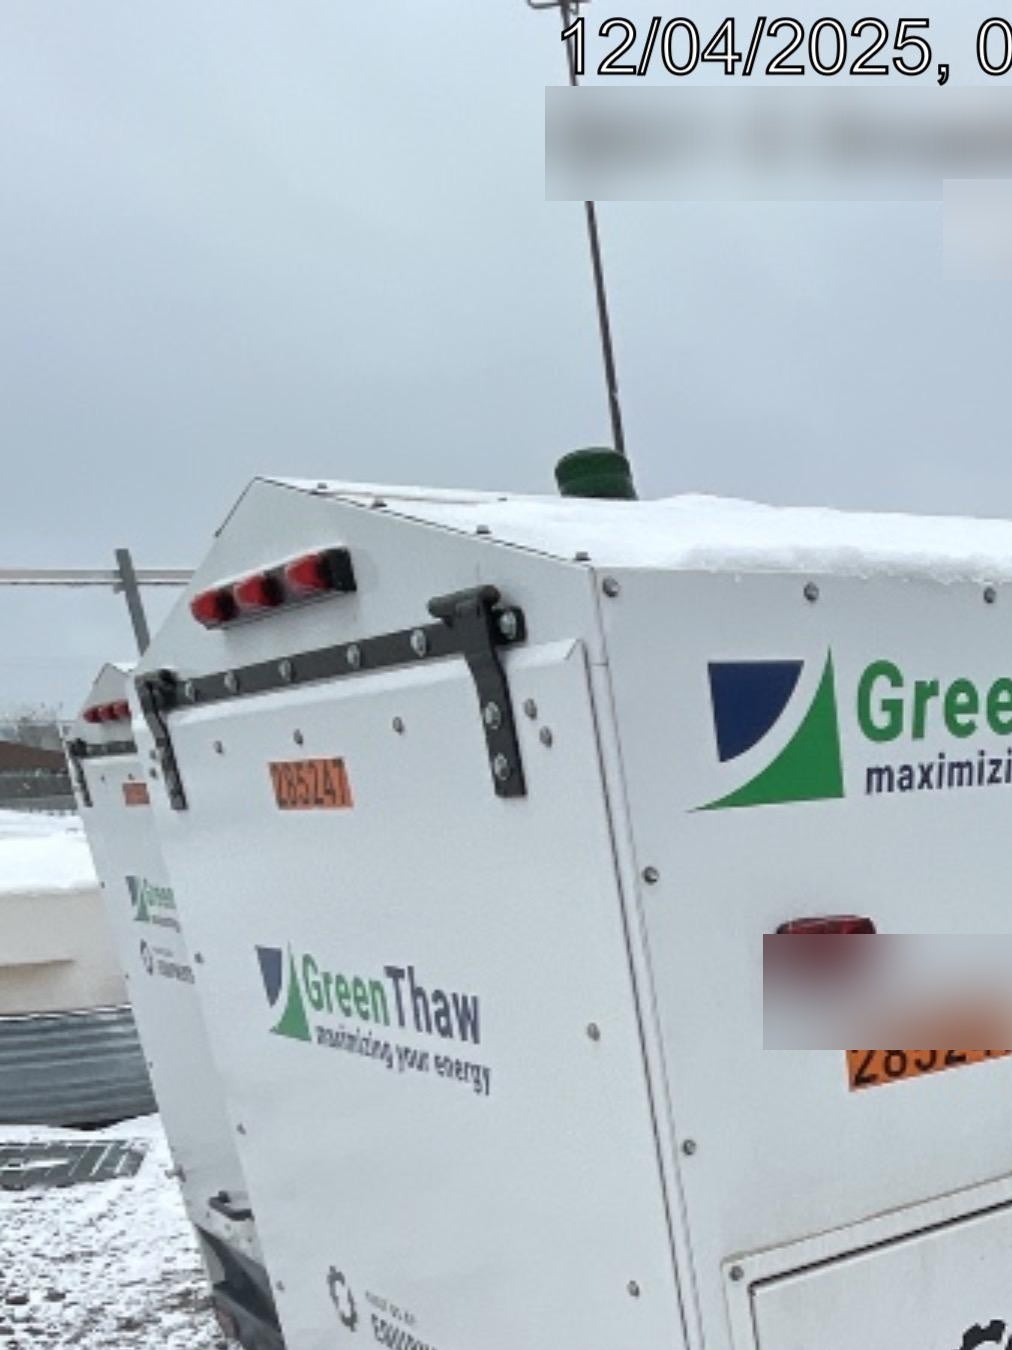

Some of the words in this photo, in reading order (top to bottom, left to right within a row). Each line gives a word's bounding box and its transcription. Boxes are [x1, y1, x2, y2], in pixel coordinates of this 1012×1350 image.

[268, 757, 352, 808] 285247
[315, 1025, 394, 1070] maximizing
[396, 1044, 430, 1073] your
[433, 1053, 492, 1096] energy
